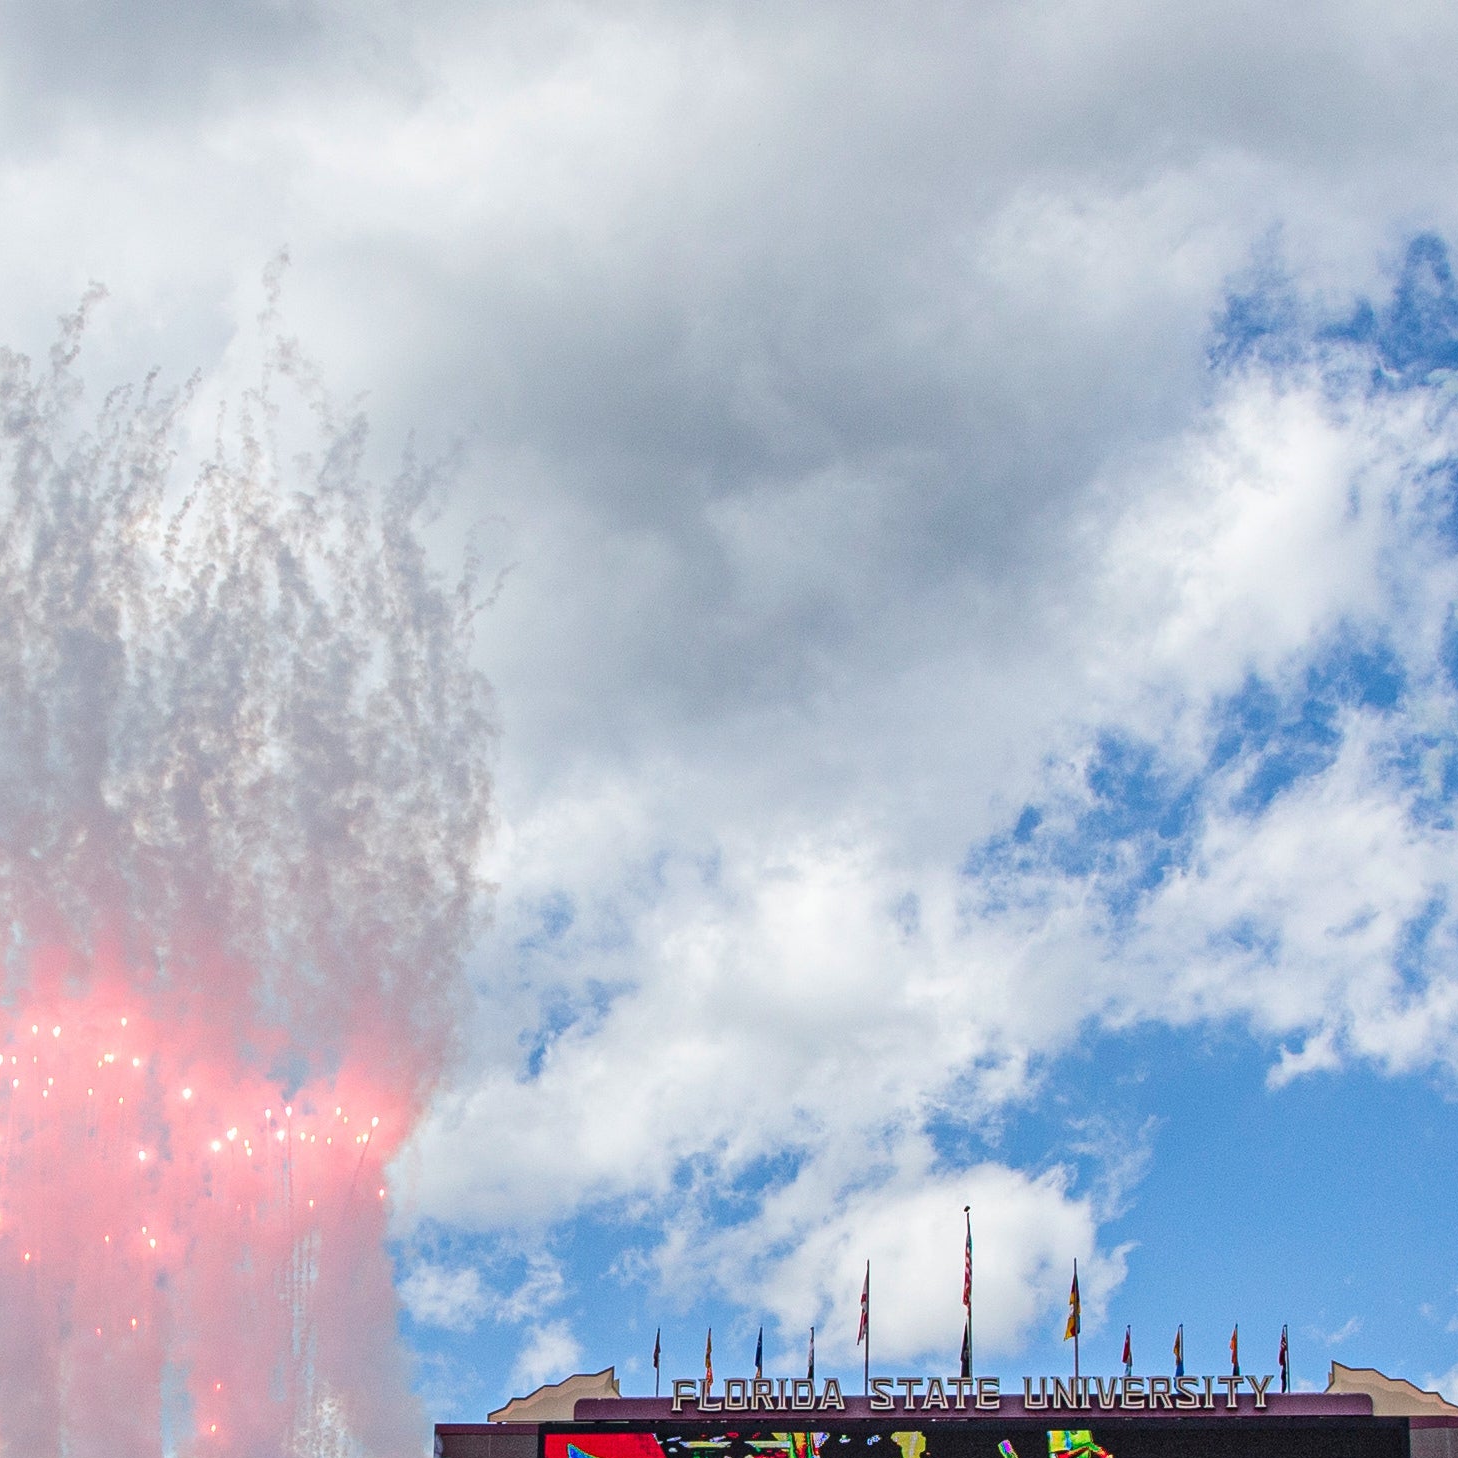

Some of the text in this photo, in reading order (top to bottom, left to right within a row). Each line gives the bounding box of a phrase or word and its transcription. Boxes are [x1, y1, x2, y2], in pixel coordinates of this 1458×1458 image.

[670, 1373, 1276, 1412] FLORIDA STATE UNIVERSITY
